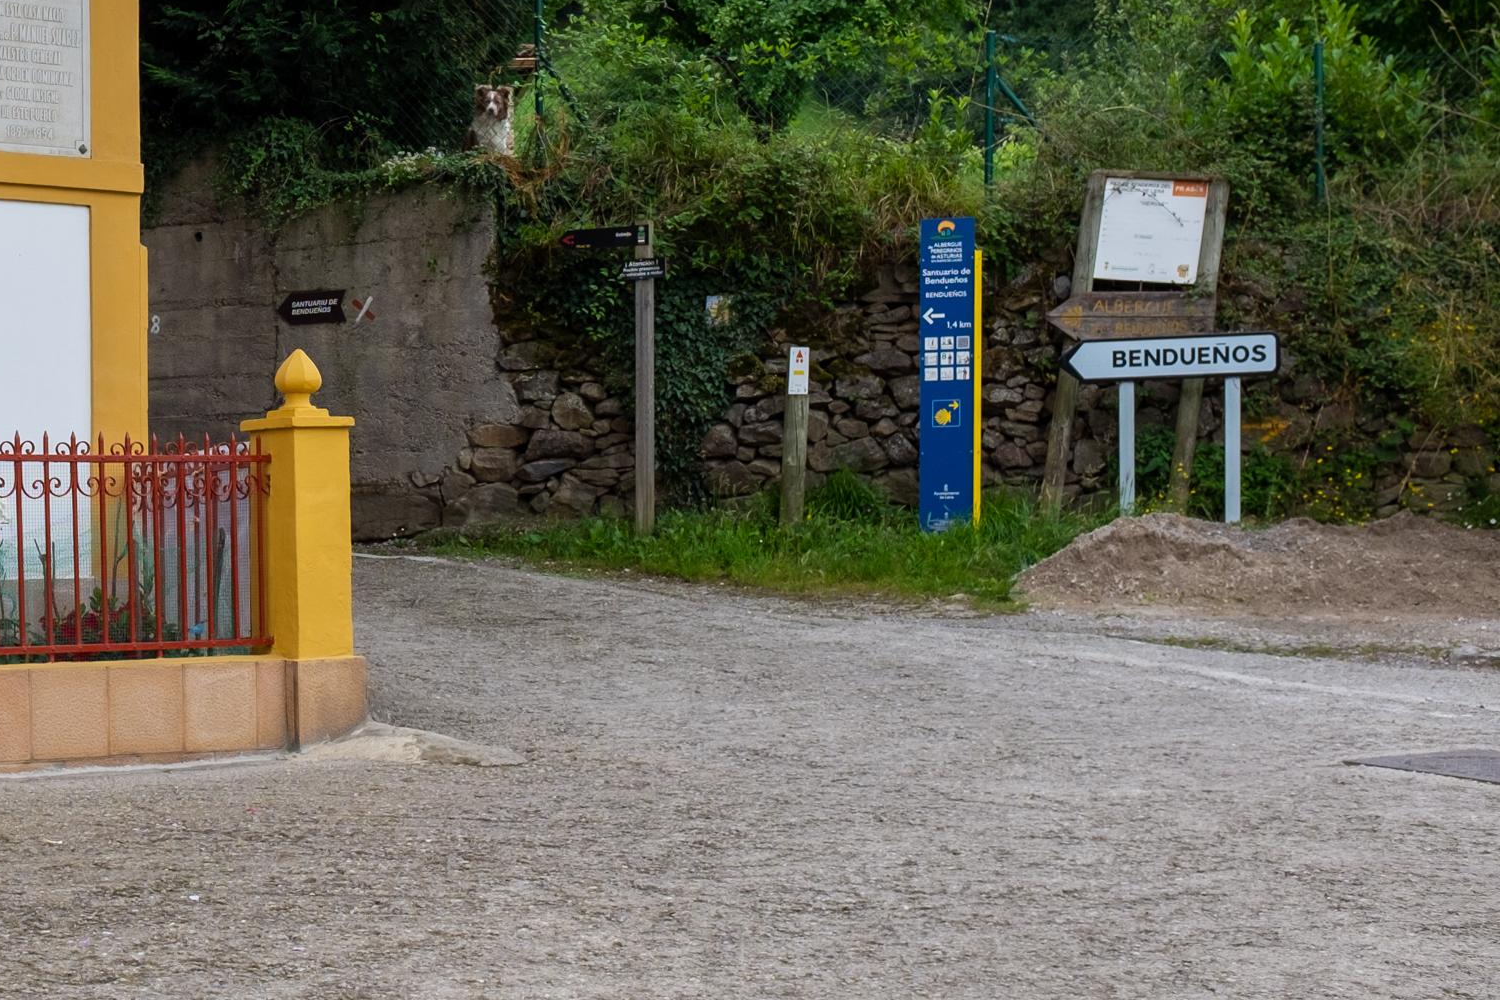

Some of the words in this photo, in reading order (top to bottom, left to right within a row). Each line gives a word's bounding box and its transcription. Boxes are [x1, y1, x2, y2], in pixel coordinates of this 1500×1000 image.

[19, 23, 51, 45] MANUEL
[30, 48, 62, 66] GENERAL
[6, 66, 30, 83] ORDEN
[6, 86, 31, 102] GLORIA
[11, 105, 28, 120] ESTE
[29, 107, 57, 123] PUEBLO
[960, 267, 971, 276] de
[924, 276, 968, 285] Bendueños
[925, 289, 967, 299] BENDUEÑOS
[328, 298, 338, 306] DE
[291, 306, 332, 316] BENDUEÑOS
[946, 320, 958, 330] 1,4
[959, 320, 972, 329] km
[1112, 342, 1267, 369] BENDUEÑOS
